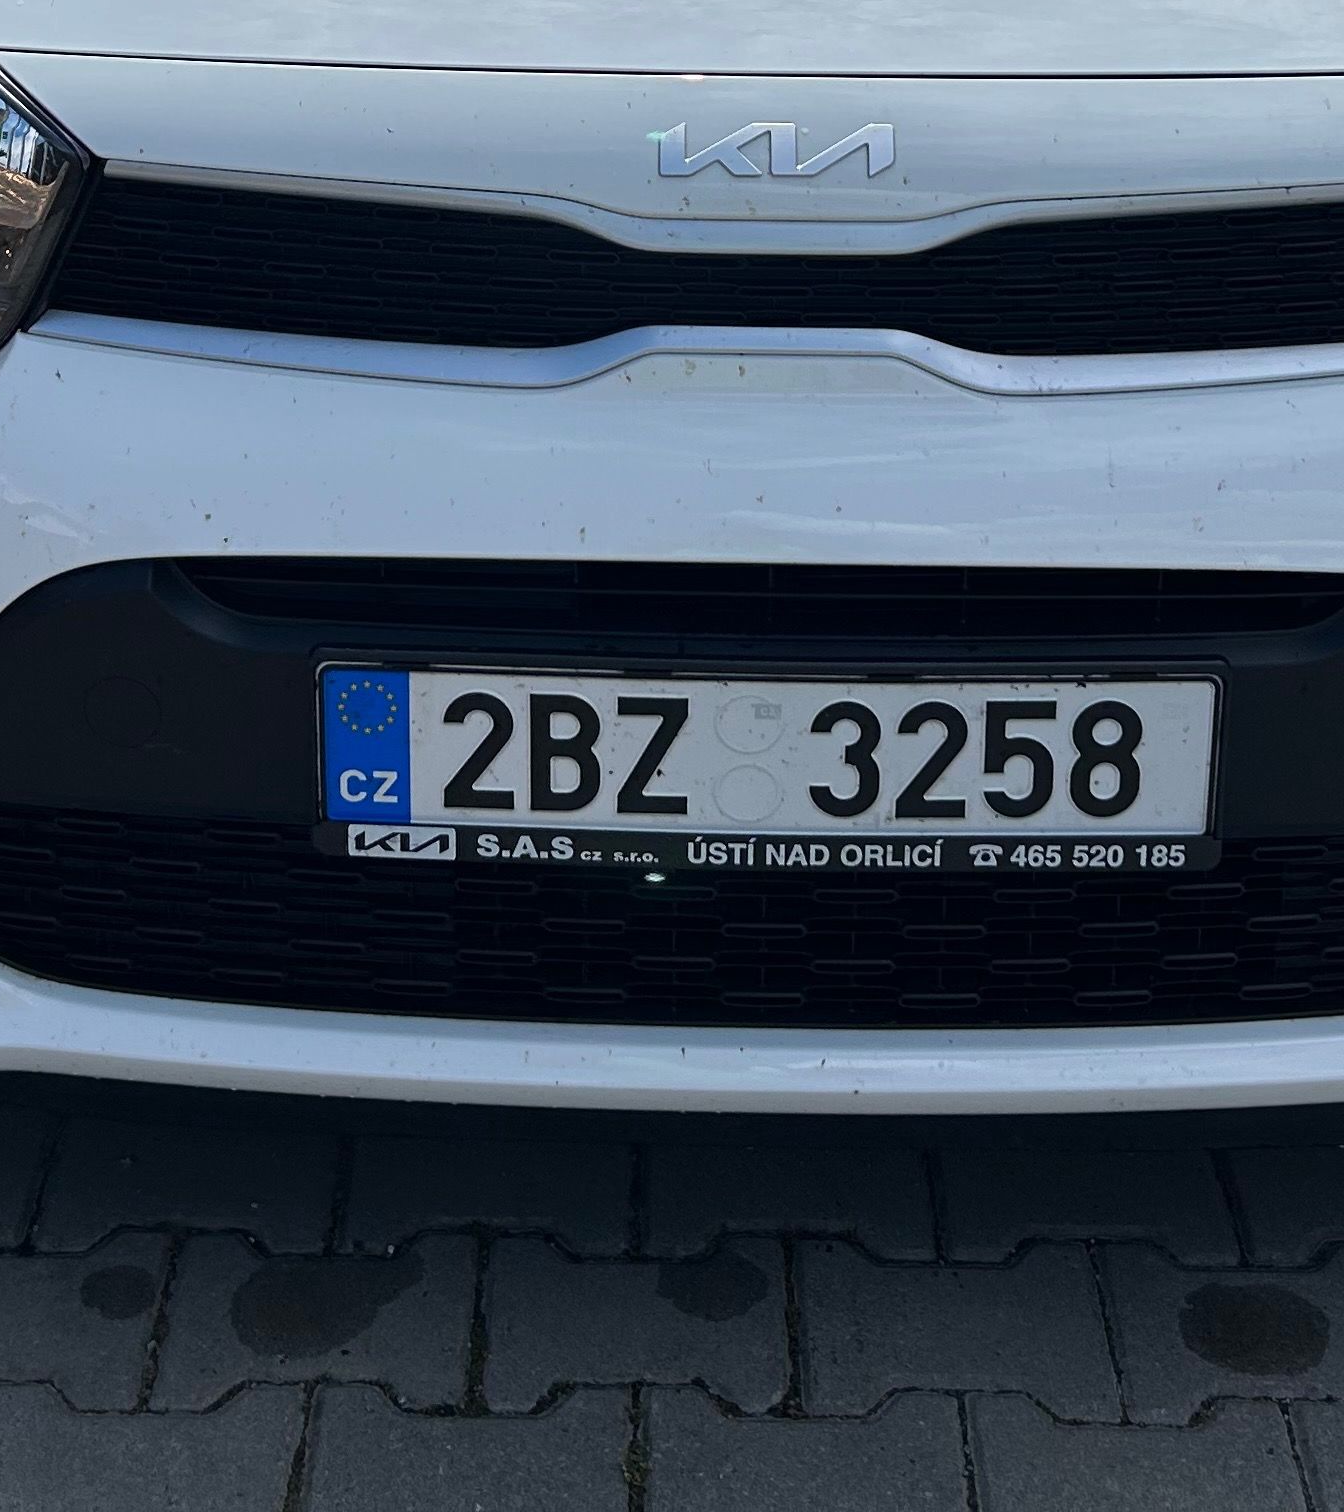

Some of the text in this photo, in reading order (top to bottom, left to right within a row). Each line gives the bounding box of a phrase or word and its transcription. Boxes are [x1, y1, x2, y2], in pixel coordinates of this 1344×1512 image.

[659, 121, 895, 178] KIA
[443, 691, 1144, 819] 2BZ 3258
[339, 768, 399, 803] CZ
[354, 830, 450, 854] KIA
[476, 833, 575, 860] S.A.S
[612, 850, 660, 863] s.r.o.
[687, 836, 757, 865] ÚSTÍ
[765, 843, 830, 866] NAD
[840, 839, 944, 867] ORLICÍ
[1009, 844, 1063, 867] 465
[1071, 844, 1126, 867] 520
[1135, 844, 1187, 867] 185
